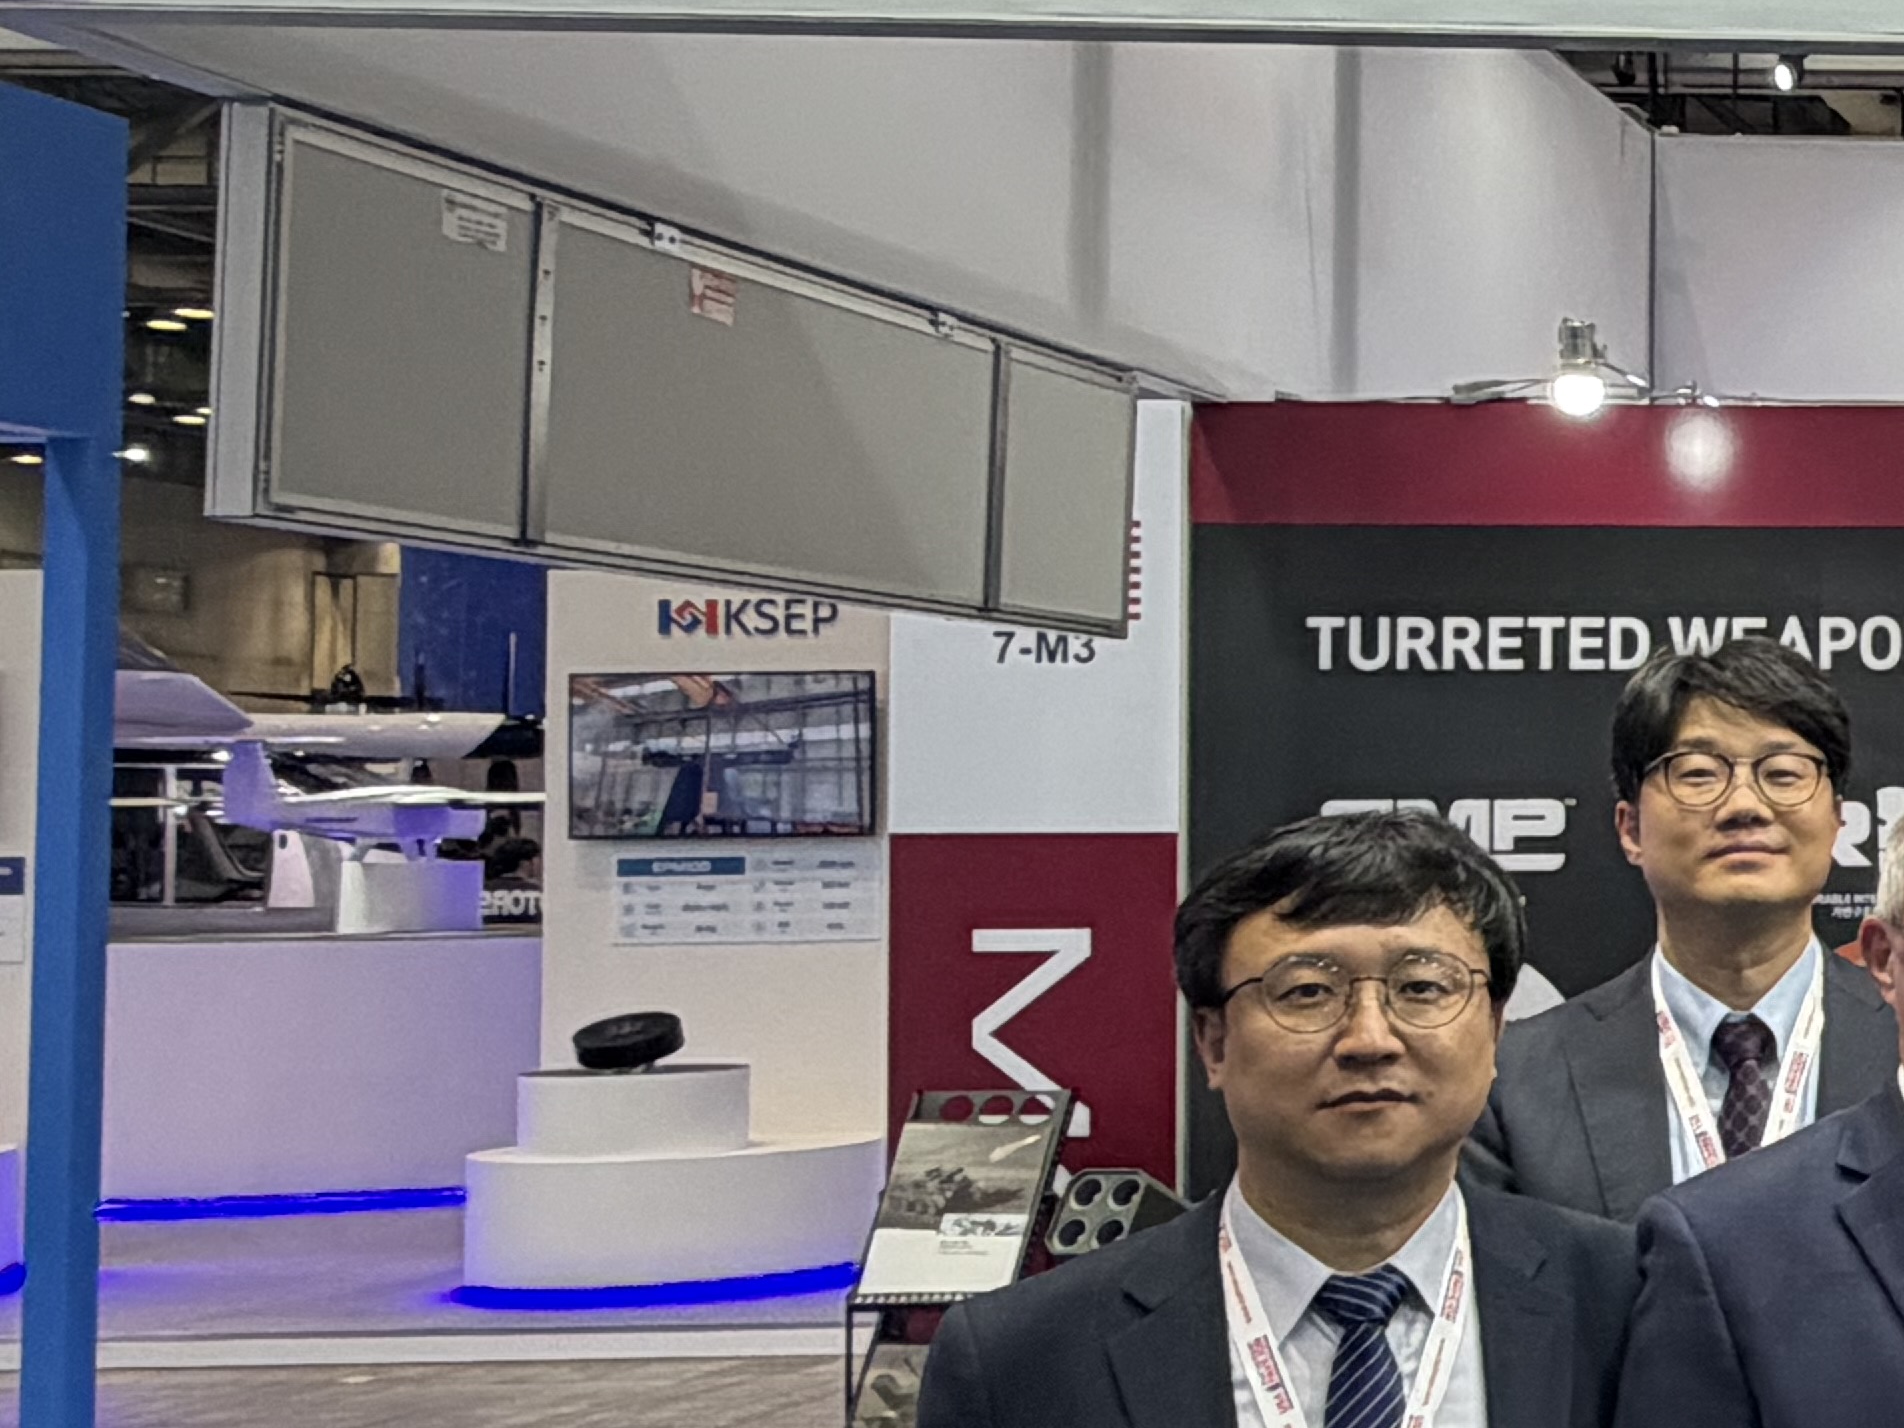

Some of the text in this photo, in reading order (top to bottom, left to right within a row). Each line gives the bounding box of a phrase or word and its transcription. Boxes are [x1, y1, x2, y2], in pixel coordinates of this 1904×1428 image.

[724, 598, 840, 636] KSEP
[992, 631, 1096, 664] 7-M3
[1306, 616, 1650, 671] TURRETED
